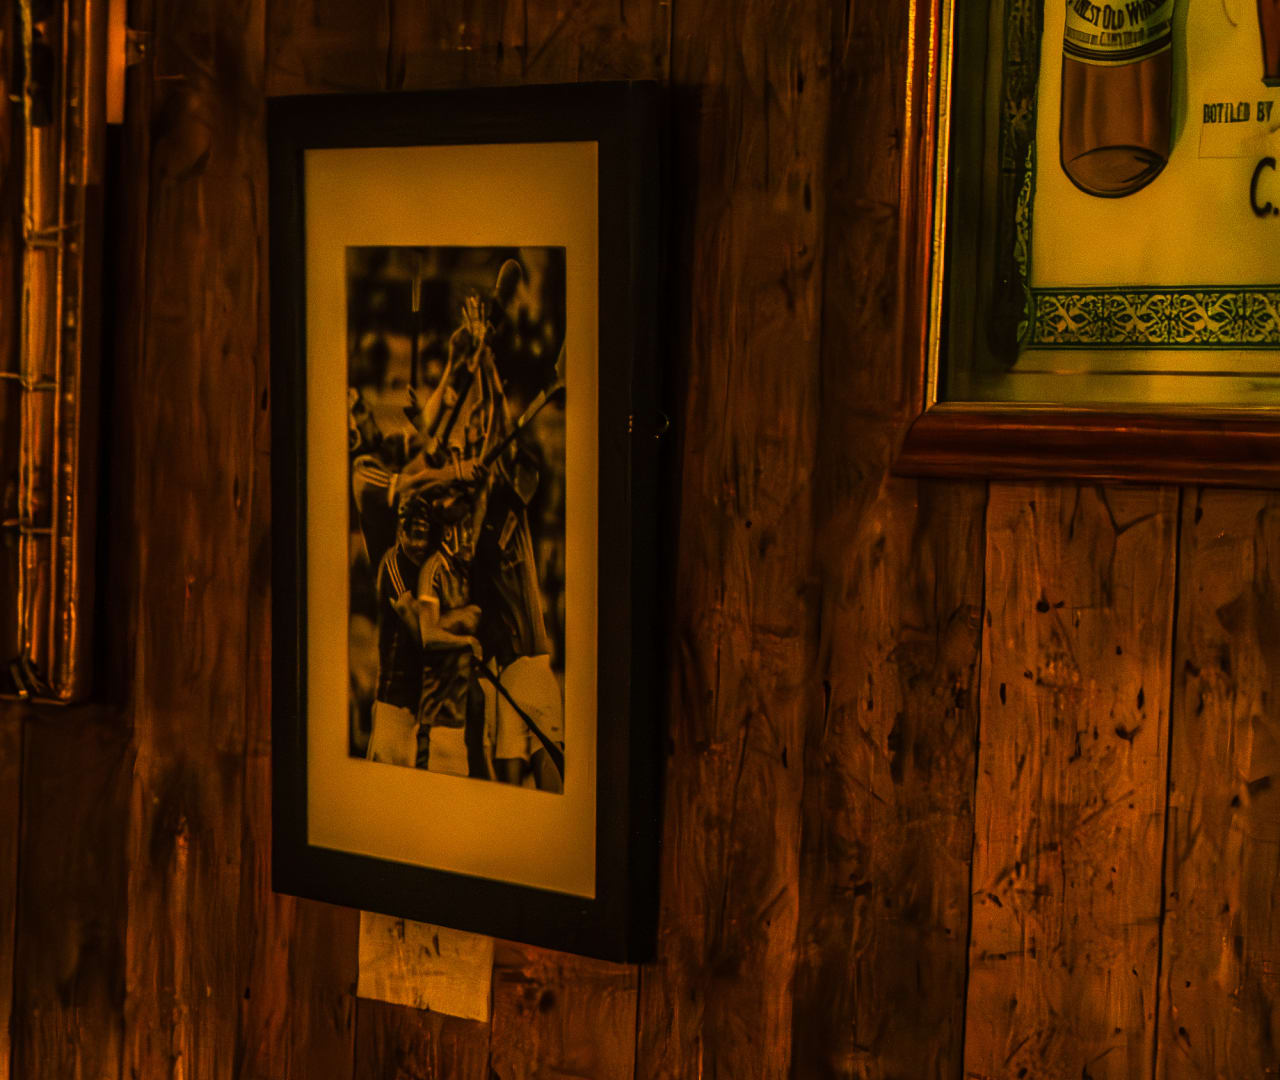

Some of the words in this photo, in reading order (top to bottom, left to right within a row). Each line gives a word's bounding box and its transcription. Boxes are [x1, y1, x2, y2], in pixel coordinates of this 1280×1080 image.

[1103, 4, 1124, 30] OLD
[1203, 101, 1250, 123] BOTTLED
[1256, 100, 1274, 122] BY
